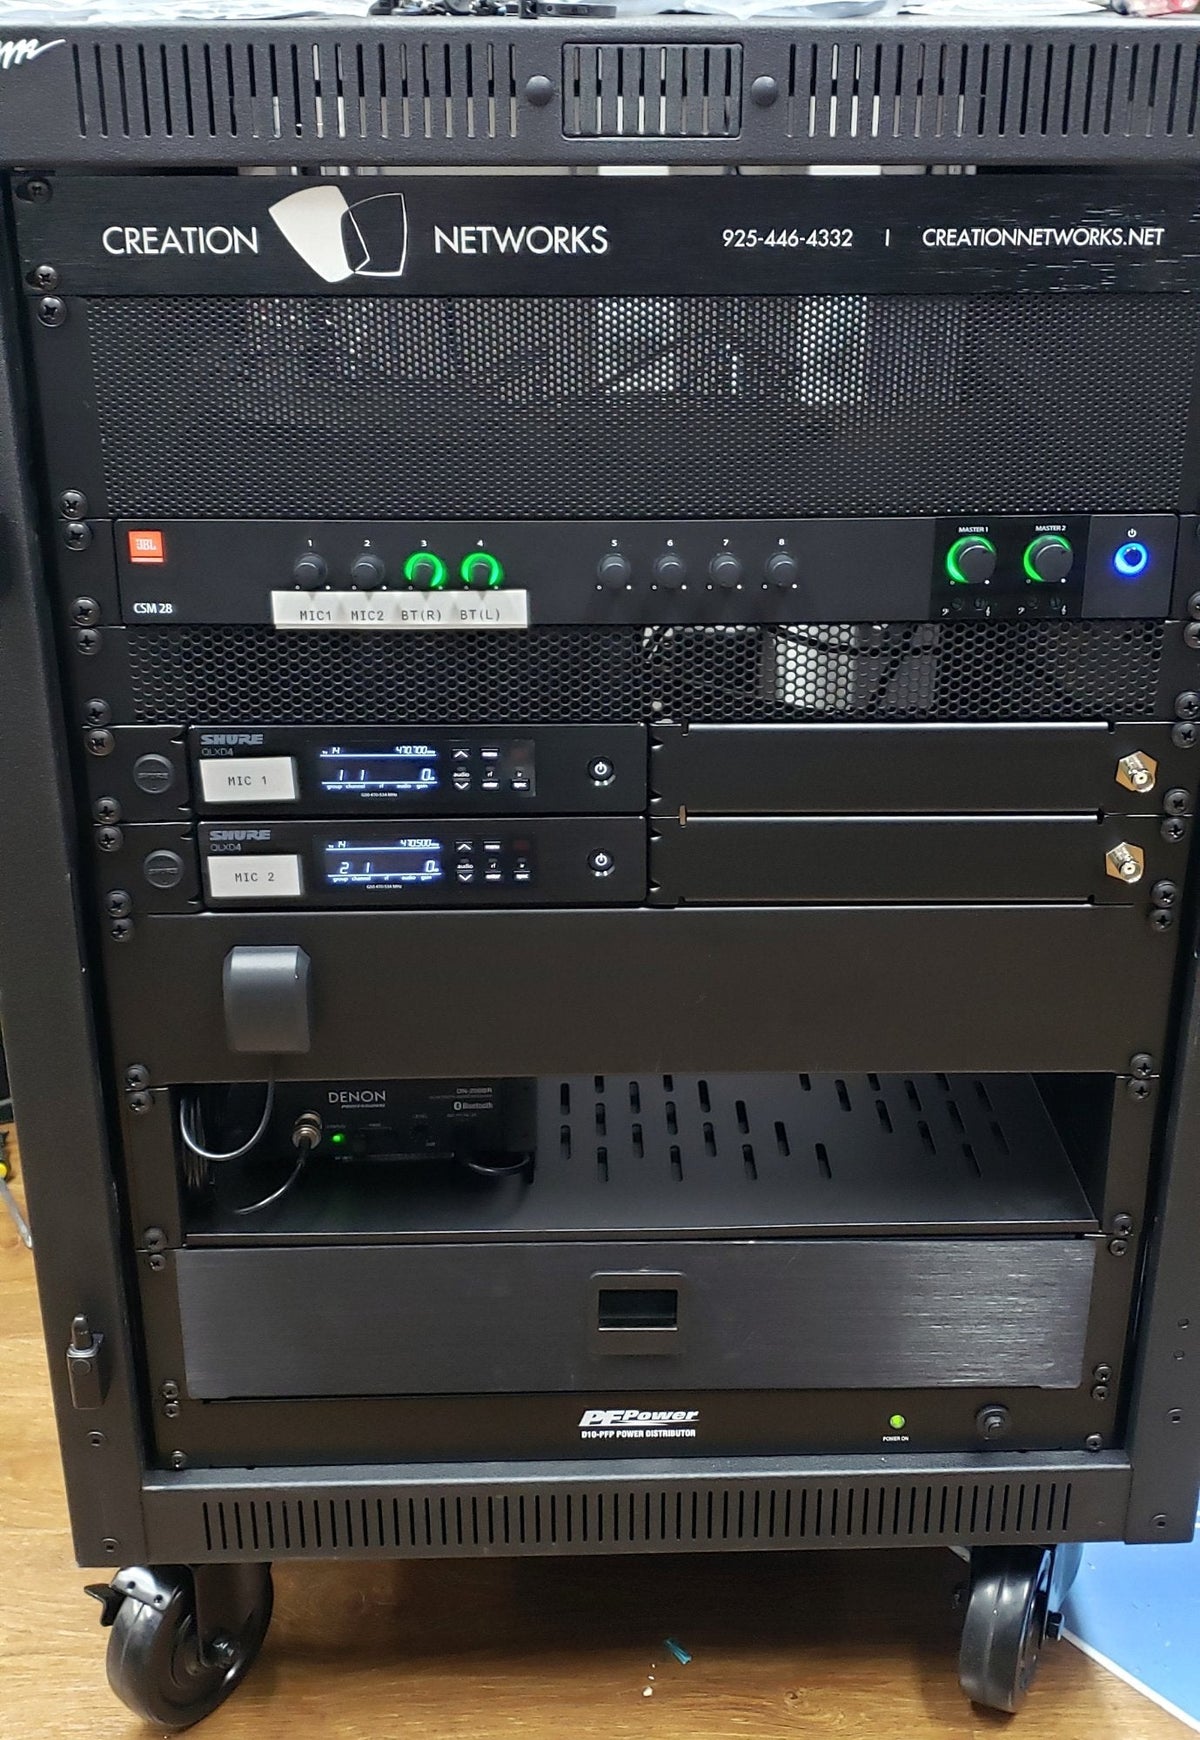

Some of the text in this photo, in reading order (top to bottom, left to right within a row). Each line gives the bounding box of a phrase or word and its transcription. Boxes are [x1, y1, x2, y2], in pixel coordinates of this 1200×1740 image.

[102, 225, 609, 255] CREATION NETWORKS
[722, 227, 1164, 248] 925-446-4332 CREATIONNETWORKS.NET
[135, 538, 157, 551] JBL
[307, 539, 313, 547] 1
[363, 539, 371, 547] 2
[420, 539, 428, 547] 3
[476, 539, 484, 547] 4
[611, 539, 618, 547] 5
[666, 539, 673, 547] 6
[778, 538, 785, 546] 8
[133, 602, 173, 614] CSM 28
[300, 609, 501, 622] MIC1 MIC2 BT(R) BT(L)
[200, 733, 264, 745] SHURE
[201, 747, 234, 756] QLXD4
[227, 775, 267, 786] MIC 1
[339, 769, 344, 781] 1
[360, 769, 365, 781] 1
[209, 830, 271, 841] SHURE
[210, 843, 241, 852] QLXD4
[340, 861, 350, 874] 2
[366, 861, 370, 873] 1
[234, 871, 275, 883] MIC 2
[328, 1090, 386, 1103] DENON
[581, 1429, 696, 1438] D10-PFP POWER DISTRIBUTOR
